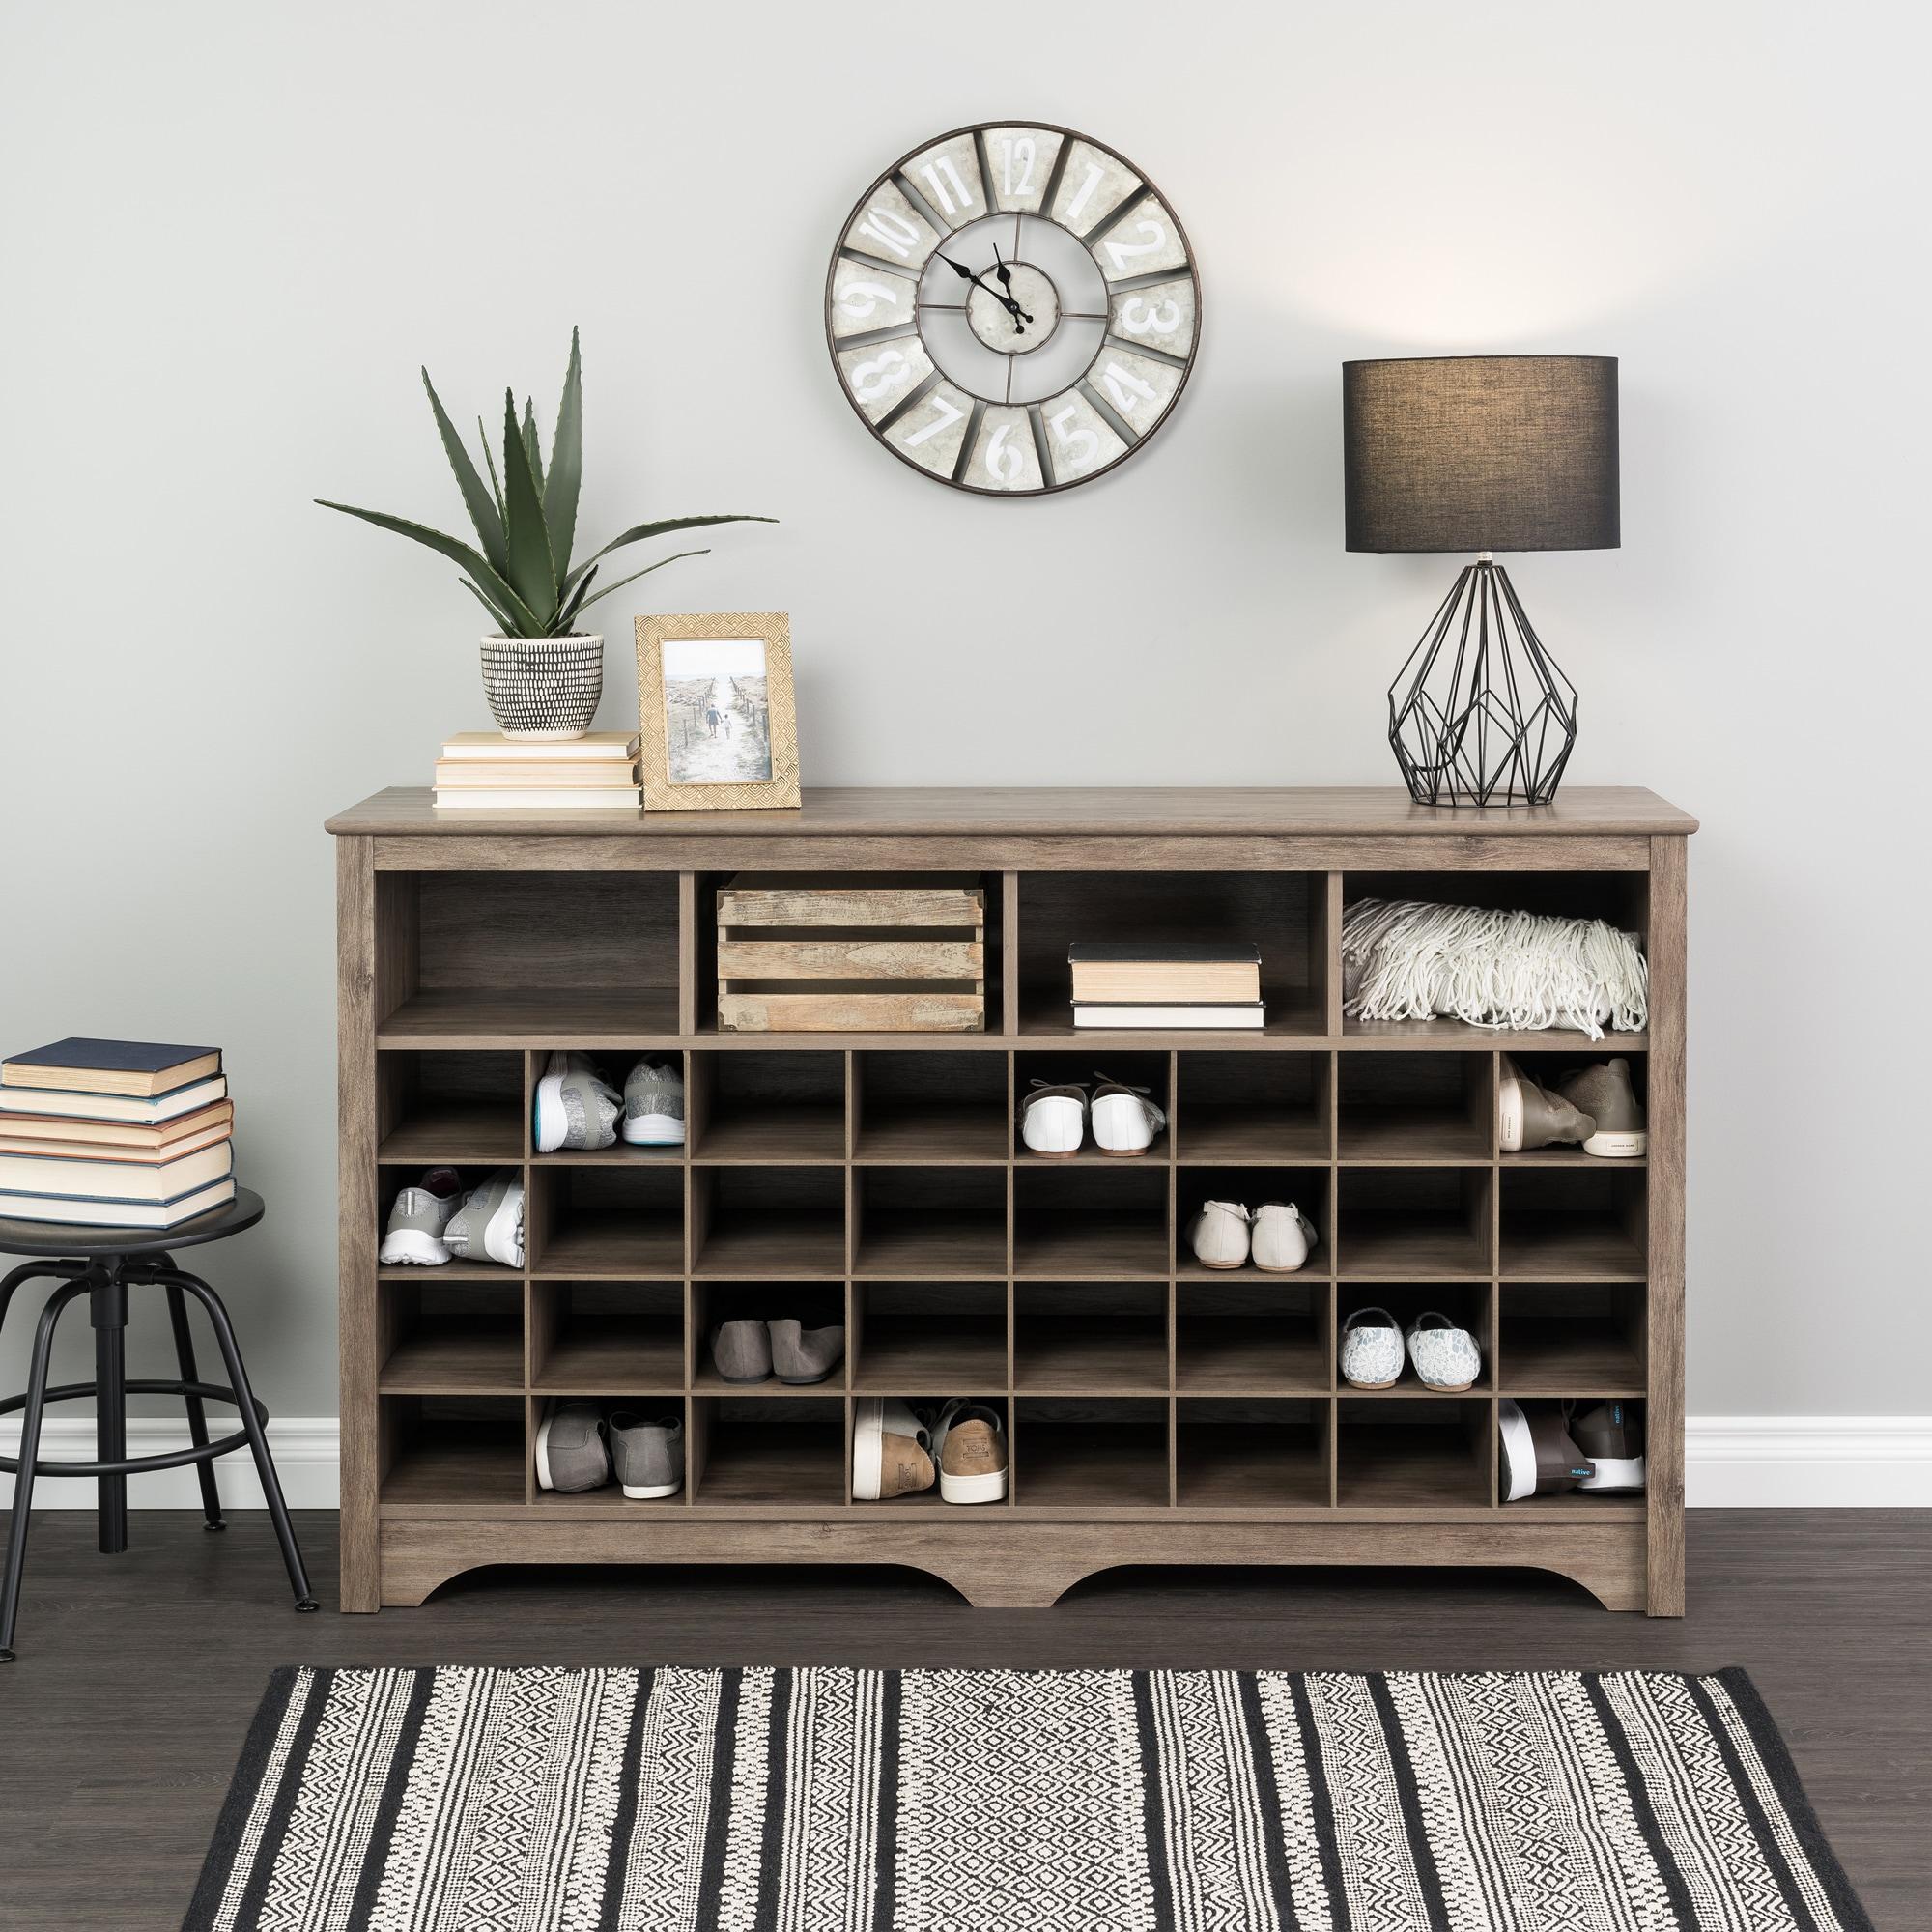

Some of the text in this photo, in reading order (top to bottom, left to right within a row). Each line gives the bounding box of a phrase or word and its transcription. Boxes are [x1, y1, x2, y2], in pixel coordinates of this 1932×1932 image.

[921, 156, 974, 214] 11
[1001, 137, 1036, 195] 12
[1065, 161, 1104, 218] 1
[858, 206, 921, 257] 10
[1104, 220, 1166, 270] 2
[840, 282, 897, 318] 9
[1122, 298, 1180, 334] 3
[851, 350, 911, 401] 8
[1102, 361, 1157, 412] 4
[903, 396, 964, 448] 7
[1049, 406, 1099, 468] 5
[985, 424, 1023, 480] 6
